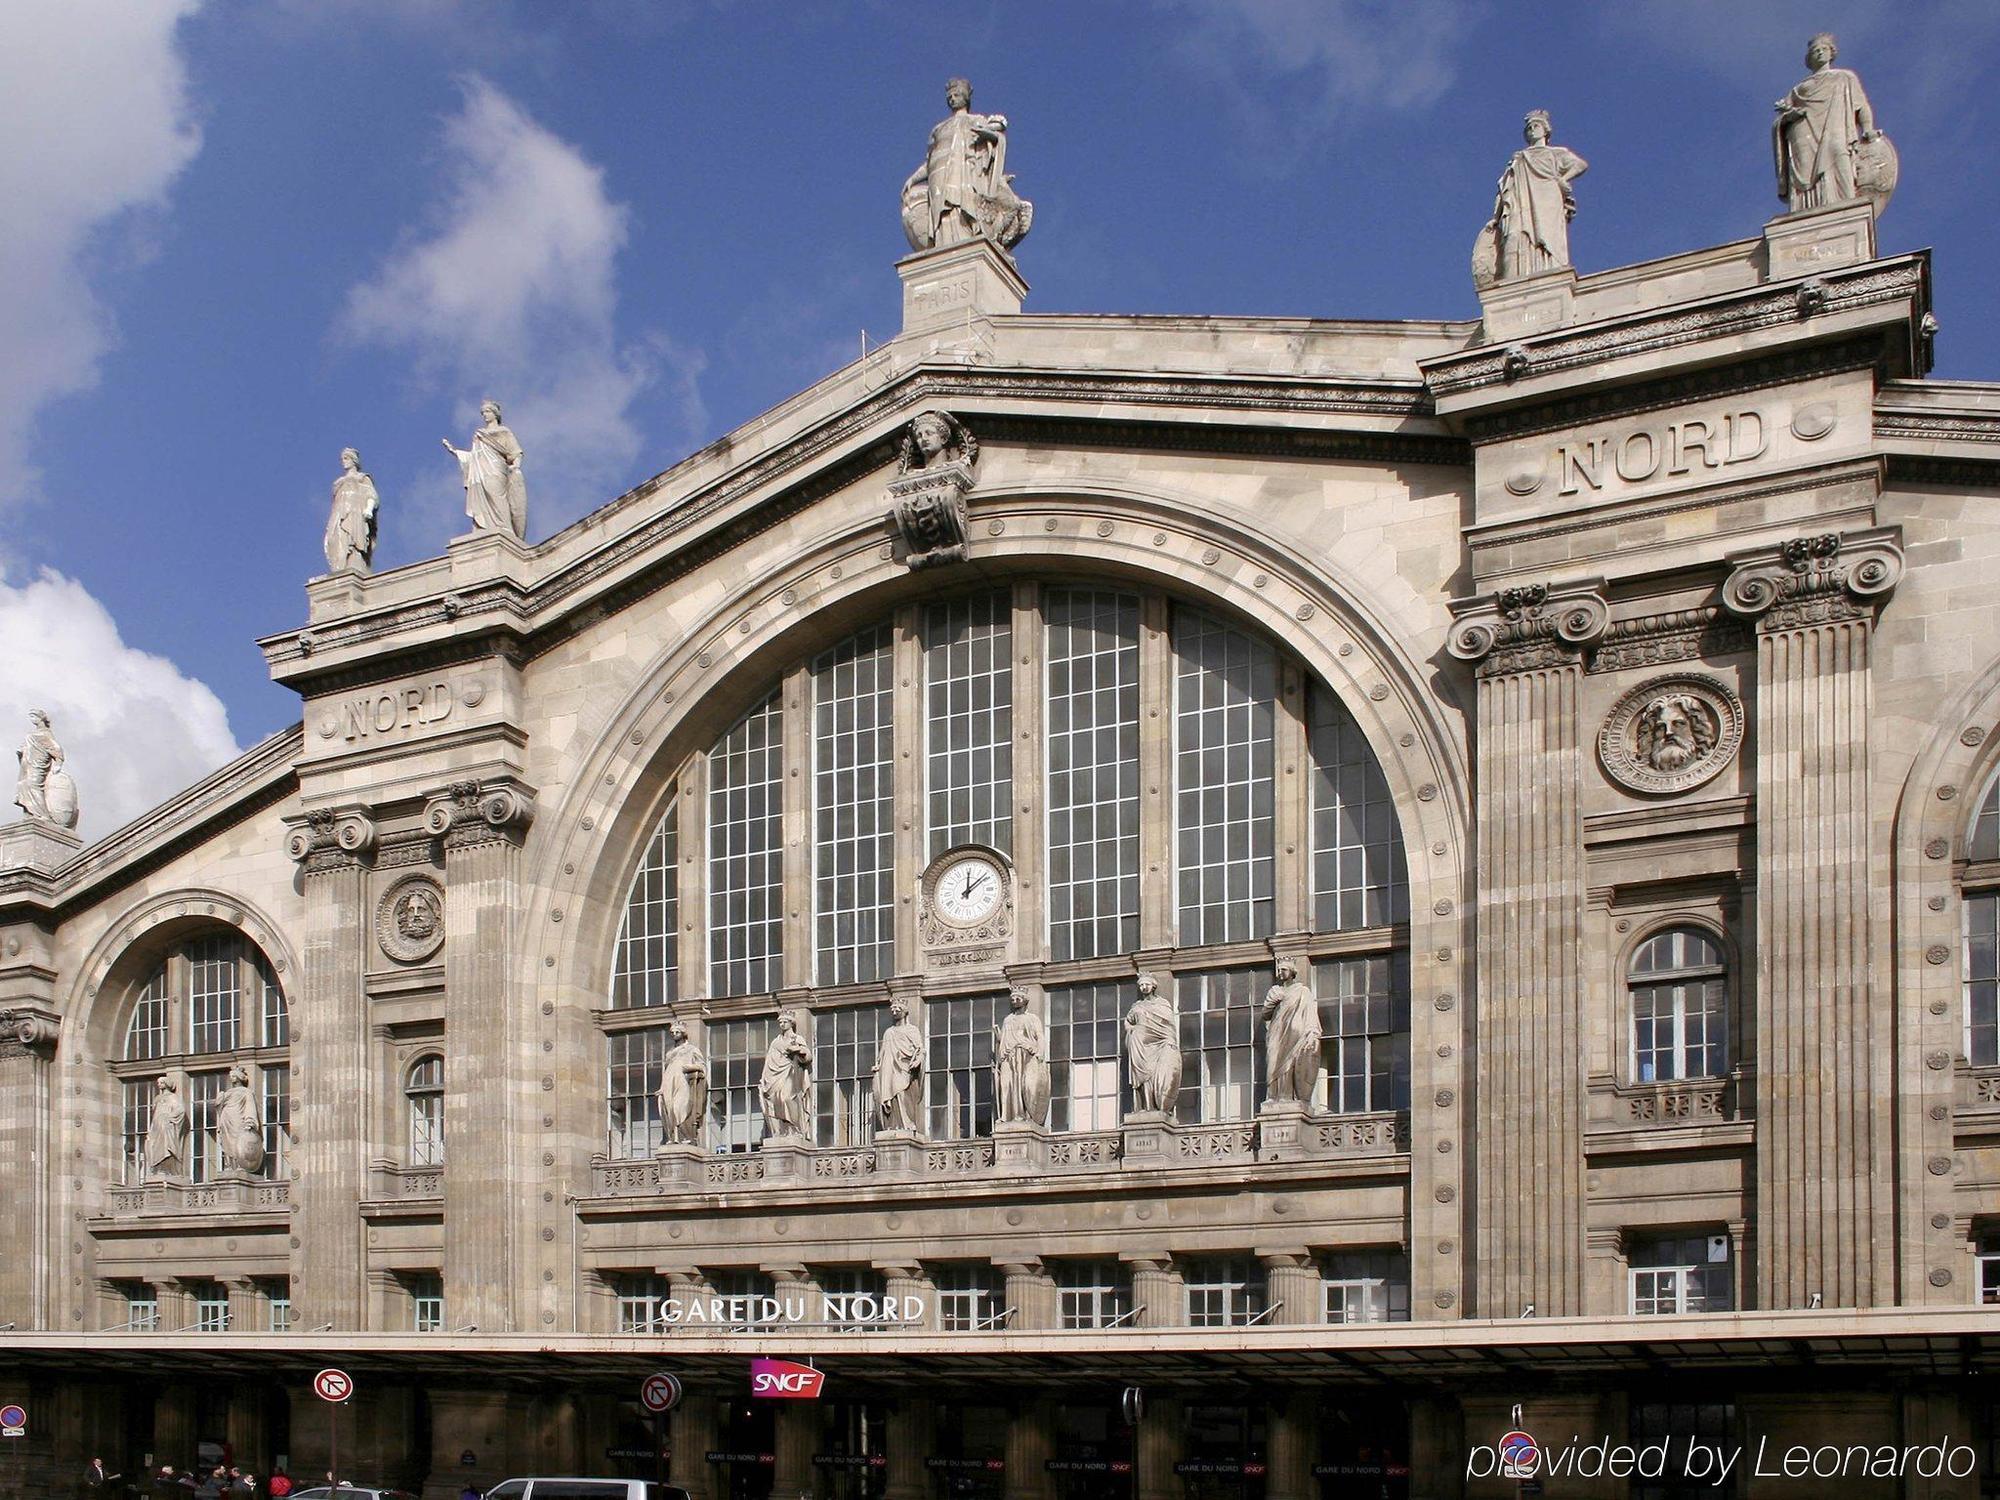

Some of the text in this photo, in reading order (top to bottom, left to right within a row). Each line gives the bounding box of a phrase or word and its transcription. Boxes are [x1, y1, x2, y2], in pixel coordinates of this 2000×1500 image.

[913, 280, 969, 312] PARIS
[1557, 411, 1769, 497] NORD
[343, 683, 454, 741] NORD
[660, 1295, 925, 1323] GARE DU NORD
[753, 1372, 817, 1393] SNCF
[1071, 1462, 1083, 1470] DU
[1085, 1463, 1107, 1471] NORD
[1178, 1464, 1201, 1472] GARE
[1202, 1464, 1214, 1472] DU
[1216, 1465, 1239, 1473] NORD
[1341, 1466, 1353, 1474] DU
[1356, 1466, 1380, 1474] NORD
